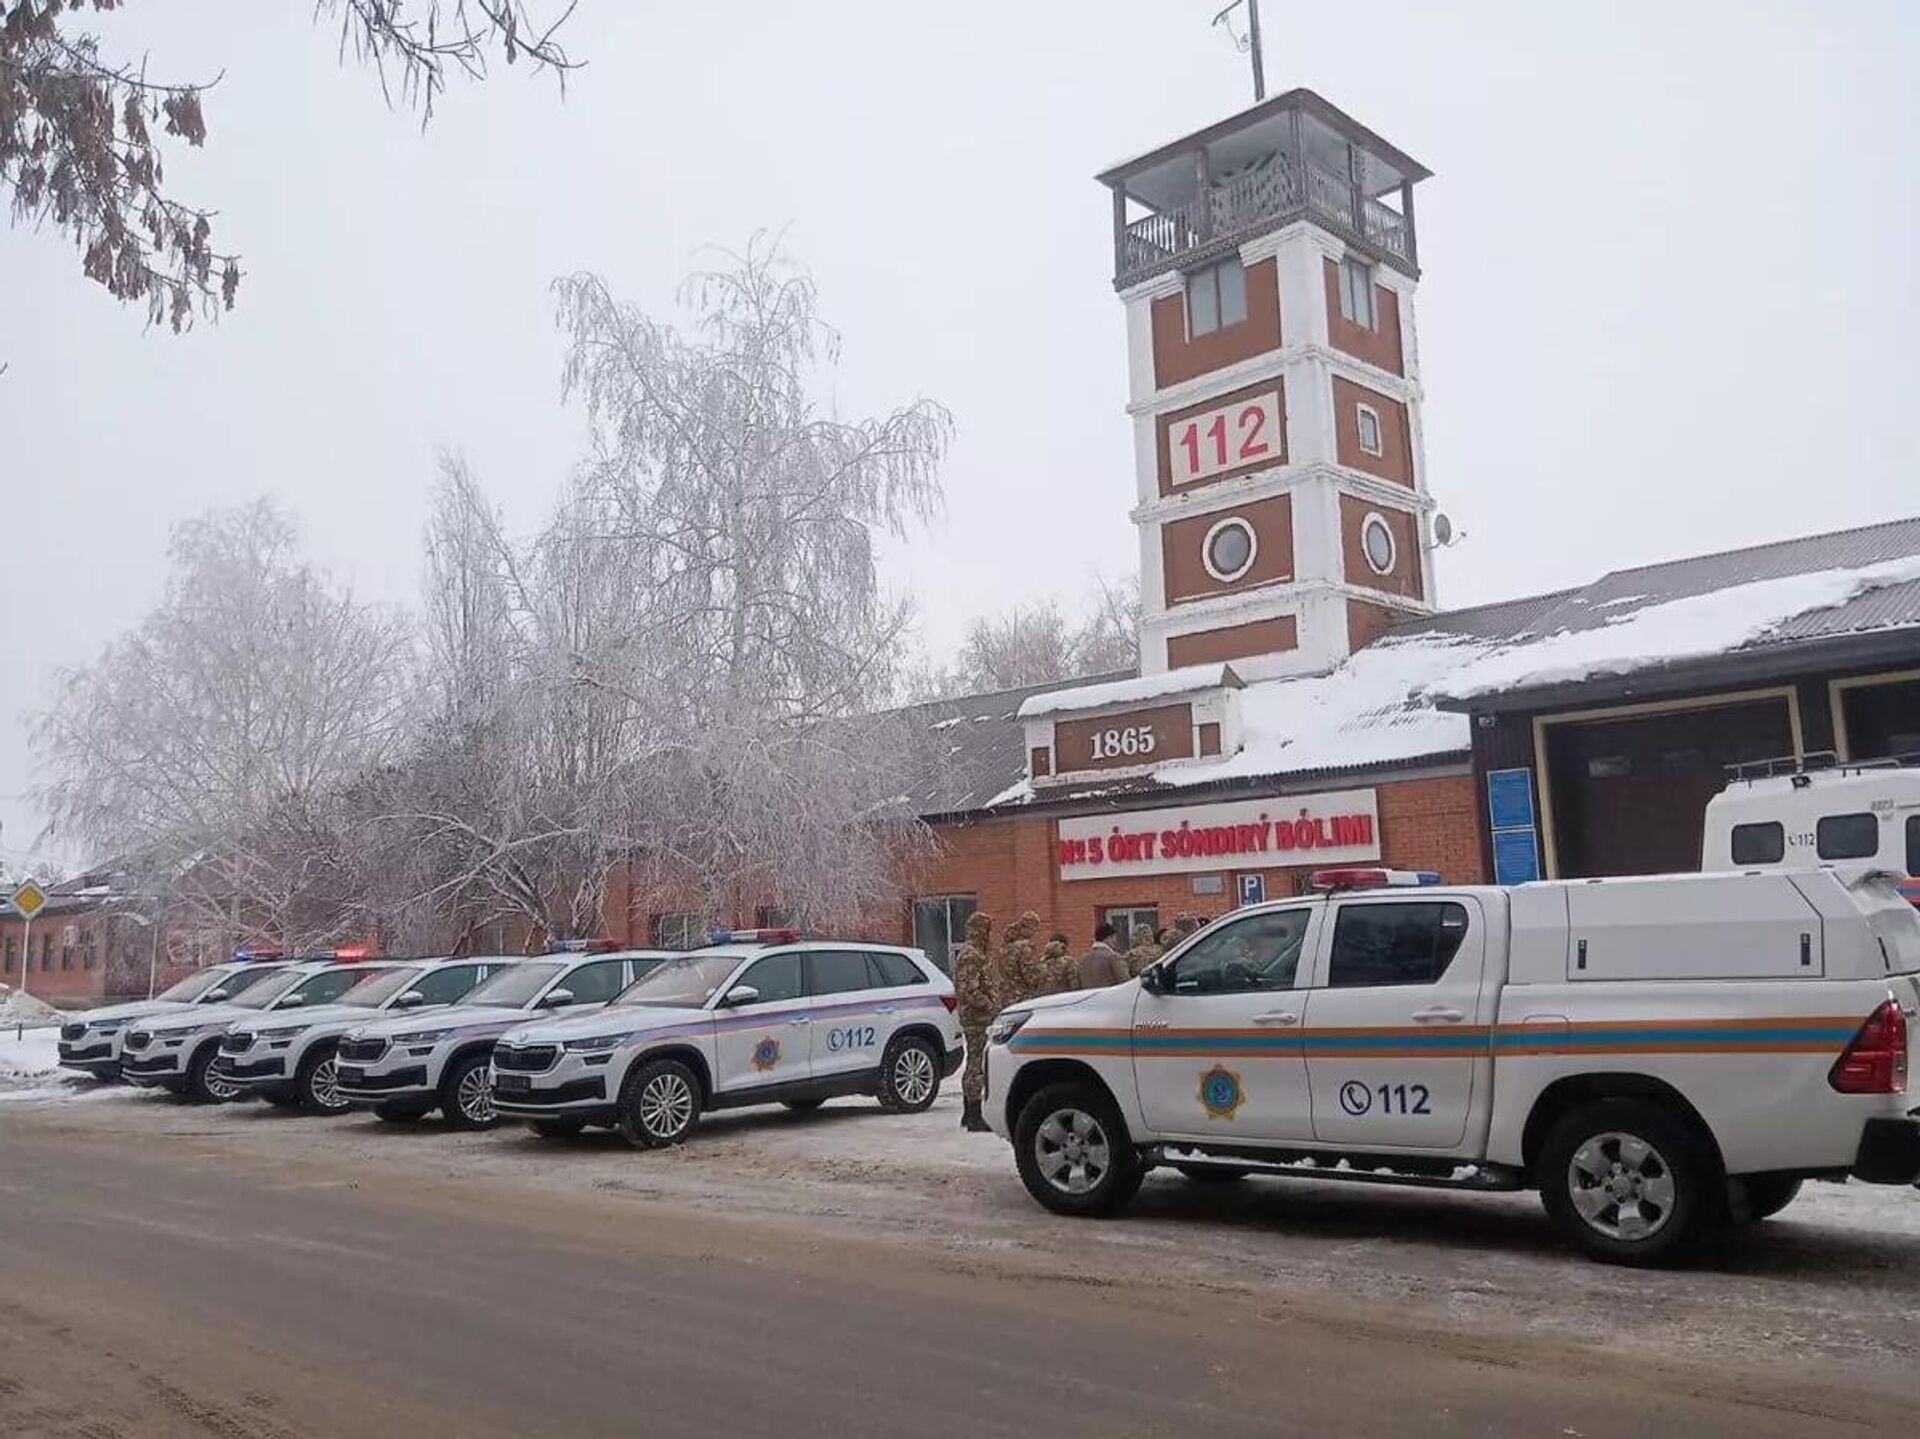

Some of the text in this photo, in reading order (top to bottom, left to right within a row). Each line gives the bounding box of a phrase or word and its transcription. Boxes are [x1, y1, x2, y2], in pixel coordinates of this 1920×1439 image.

[1180, 406, 1268, 474] 112
[1090, 725, 1155, 759] 1865
[1798, 833, 1815, 846] 112
[1245, 876, 1257, 897] P
[846, 1027, 876, 1048] 112
[1378, 1084, 1431, 1114] 112
